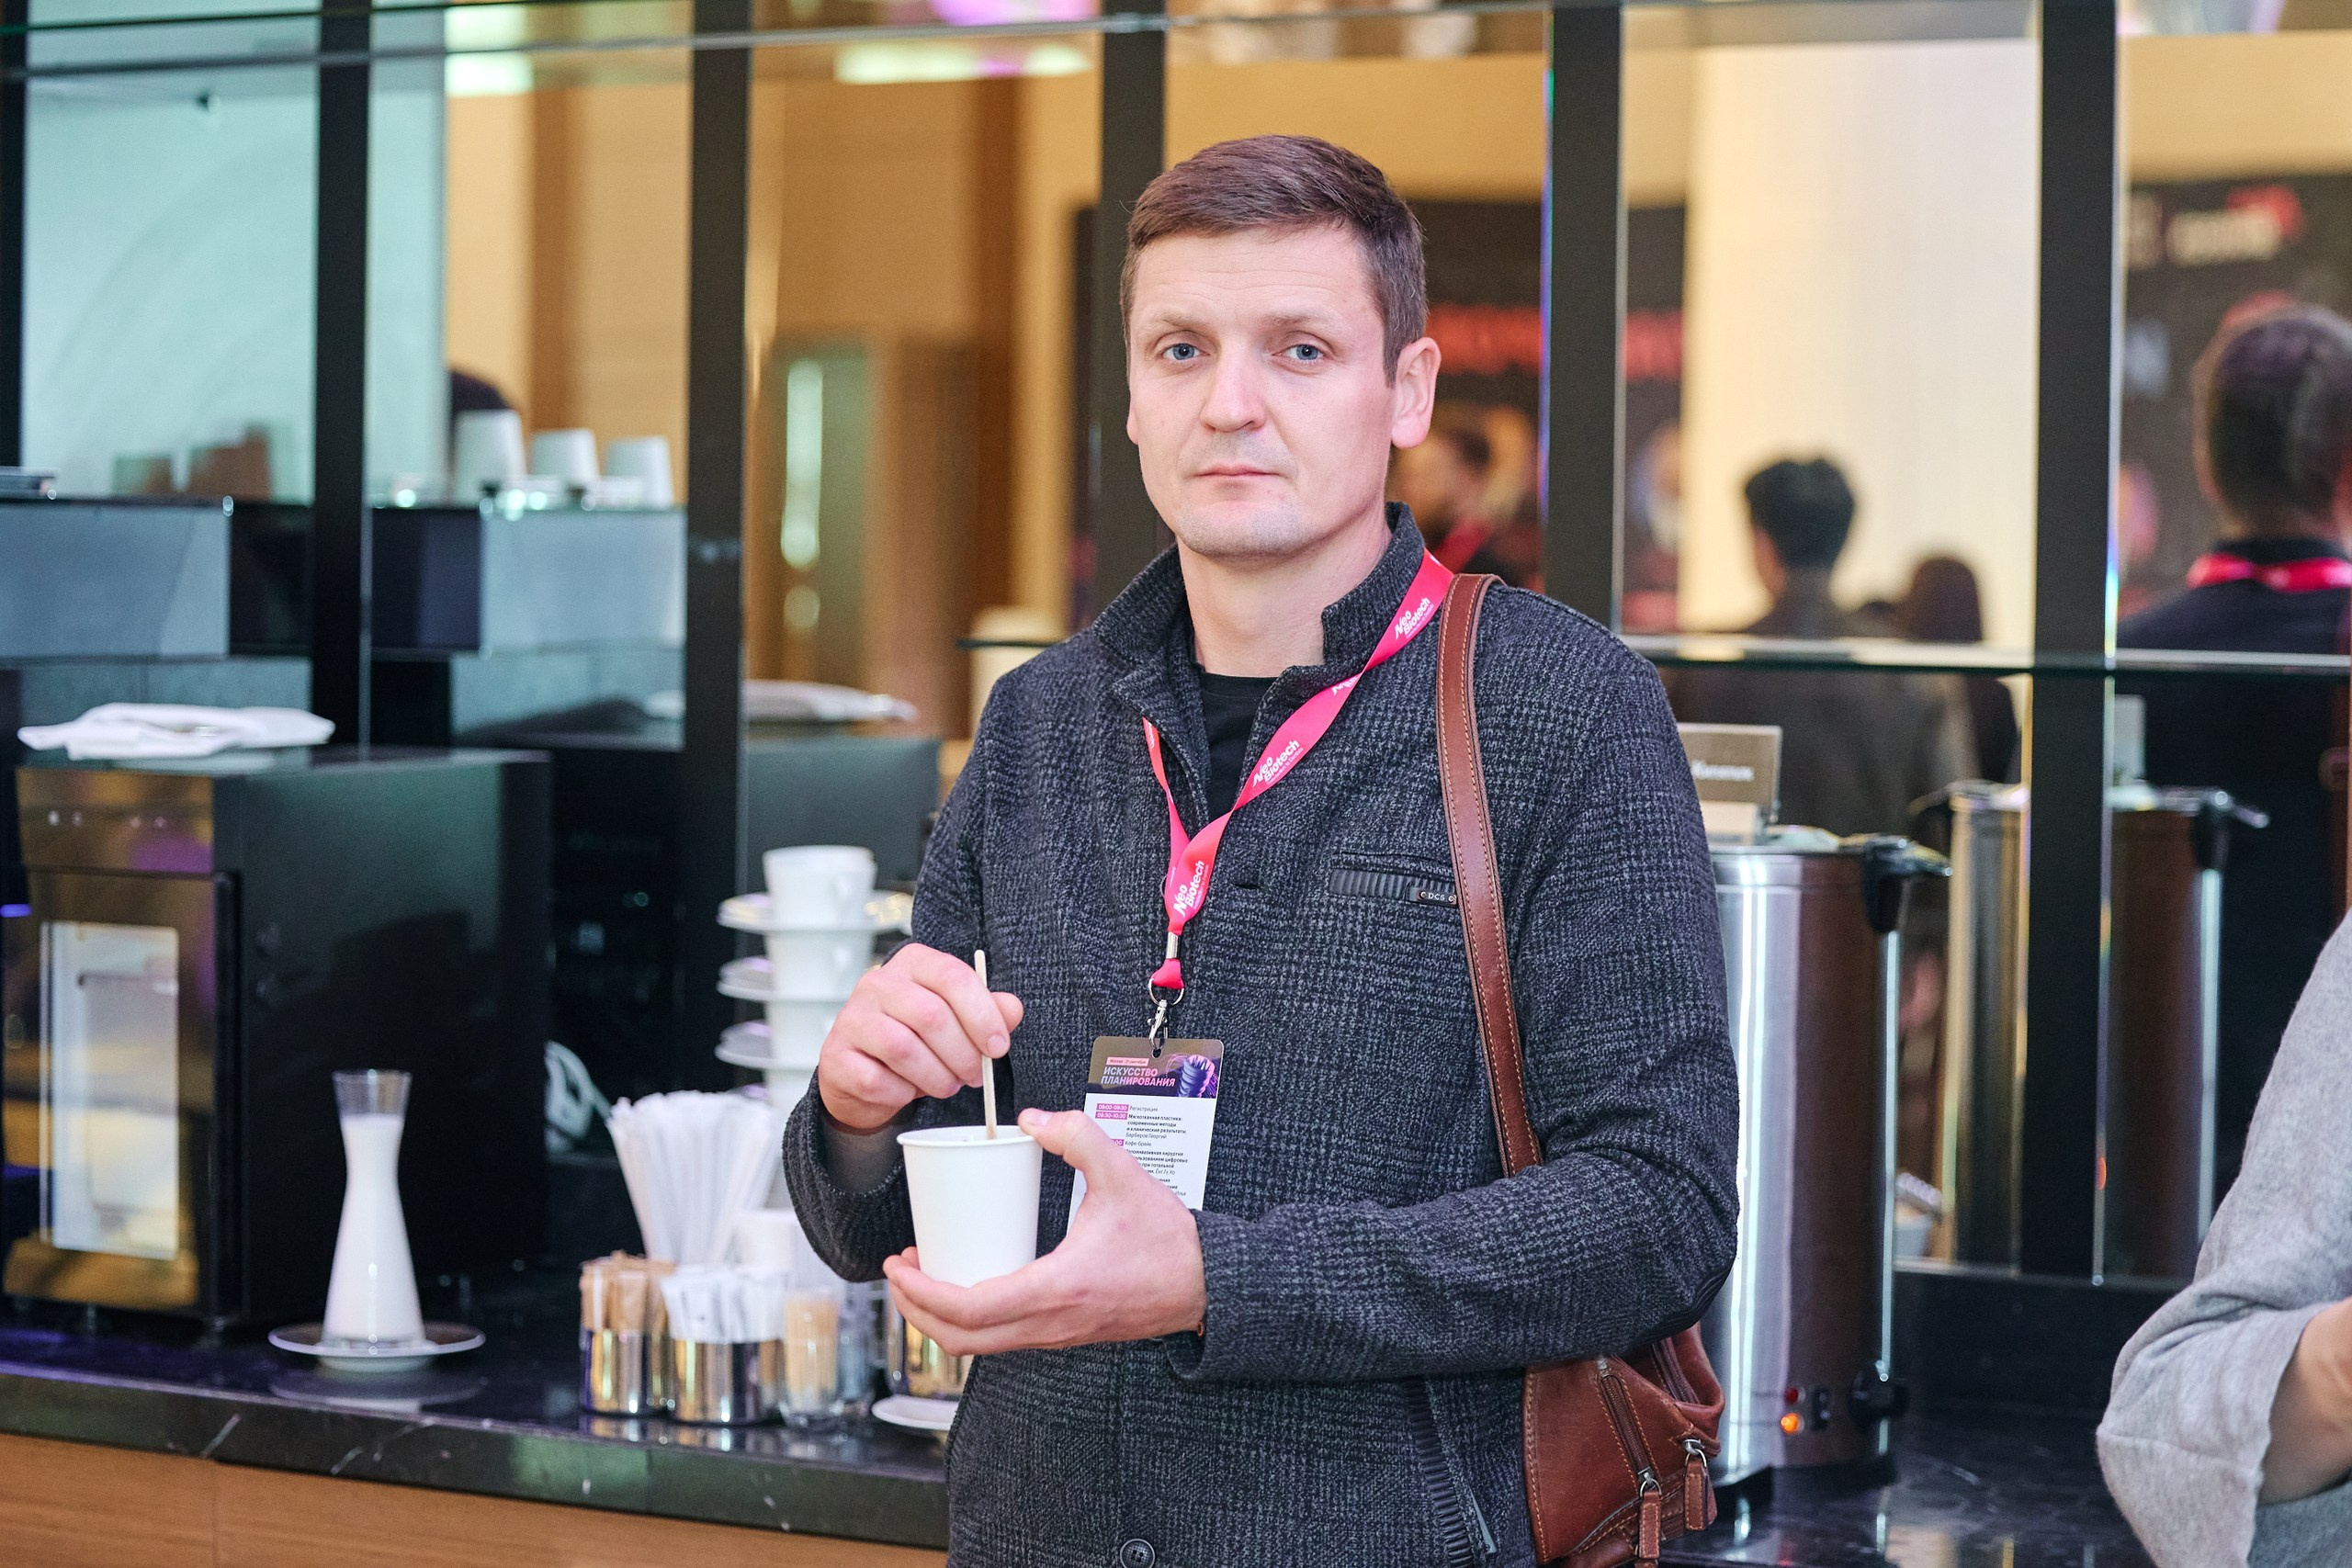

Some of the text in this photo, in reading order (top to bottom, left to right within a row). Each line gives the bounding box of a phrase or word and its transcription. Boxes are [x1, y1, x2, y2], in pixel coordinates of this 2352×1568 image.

[1395, 611, 1411, 640] Neo
[1404, 597, 1430, 635] Biotech
[1252, 757, 1272, 787] Neo
[1264, 740, 1300, 783] Biotech
[1185, 861, 1204, 908] Biotech
[1173, 885, 1188, 918] Neo
[1101, 1076, 1176, 1087] ПЛАНИРОВАНИЯ
[1103, 1066, 1158, 1077] ИСКУССТВО
